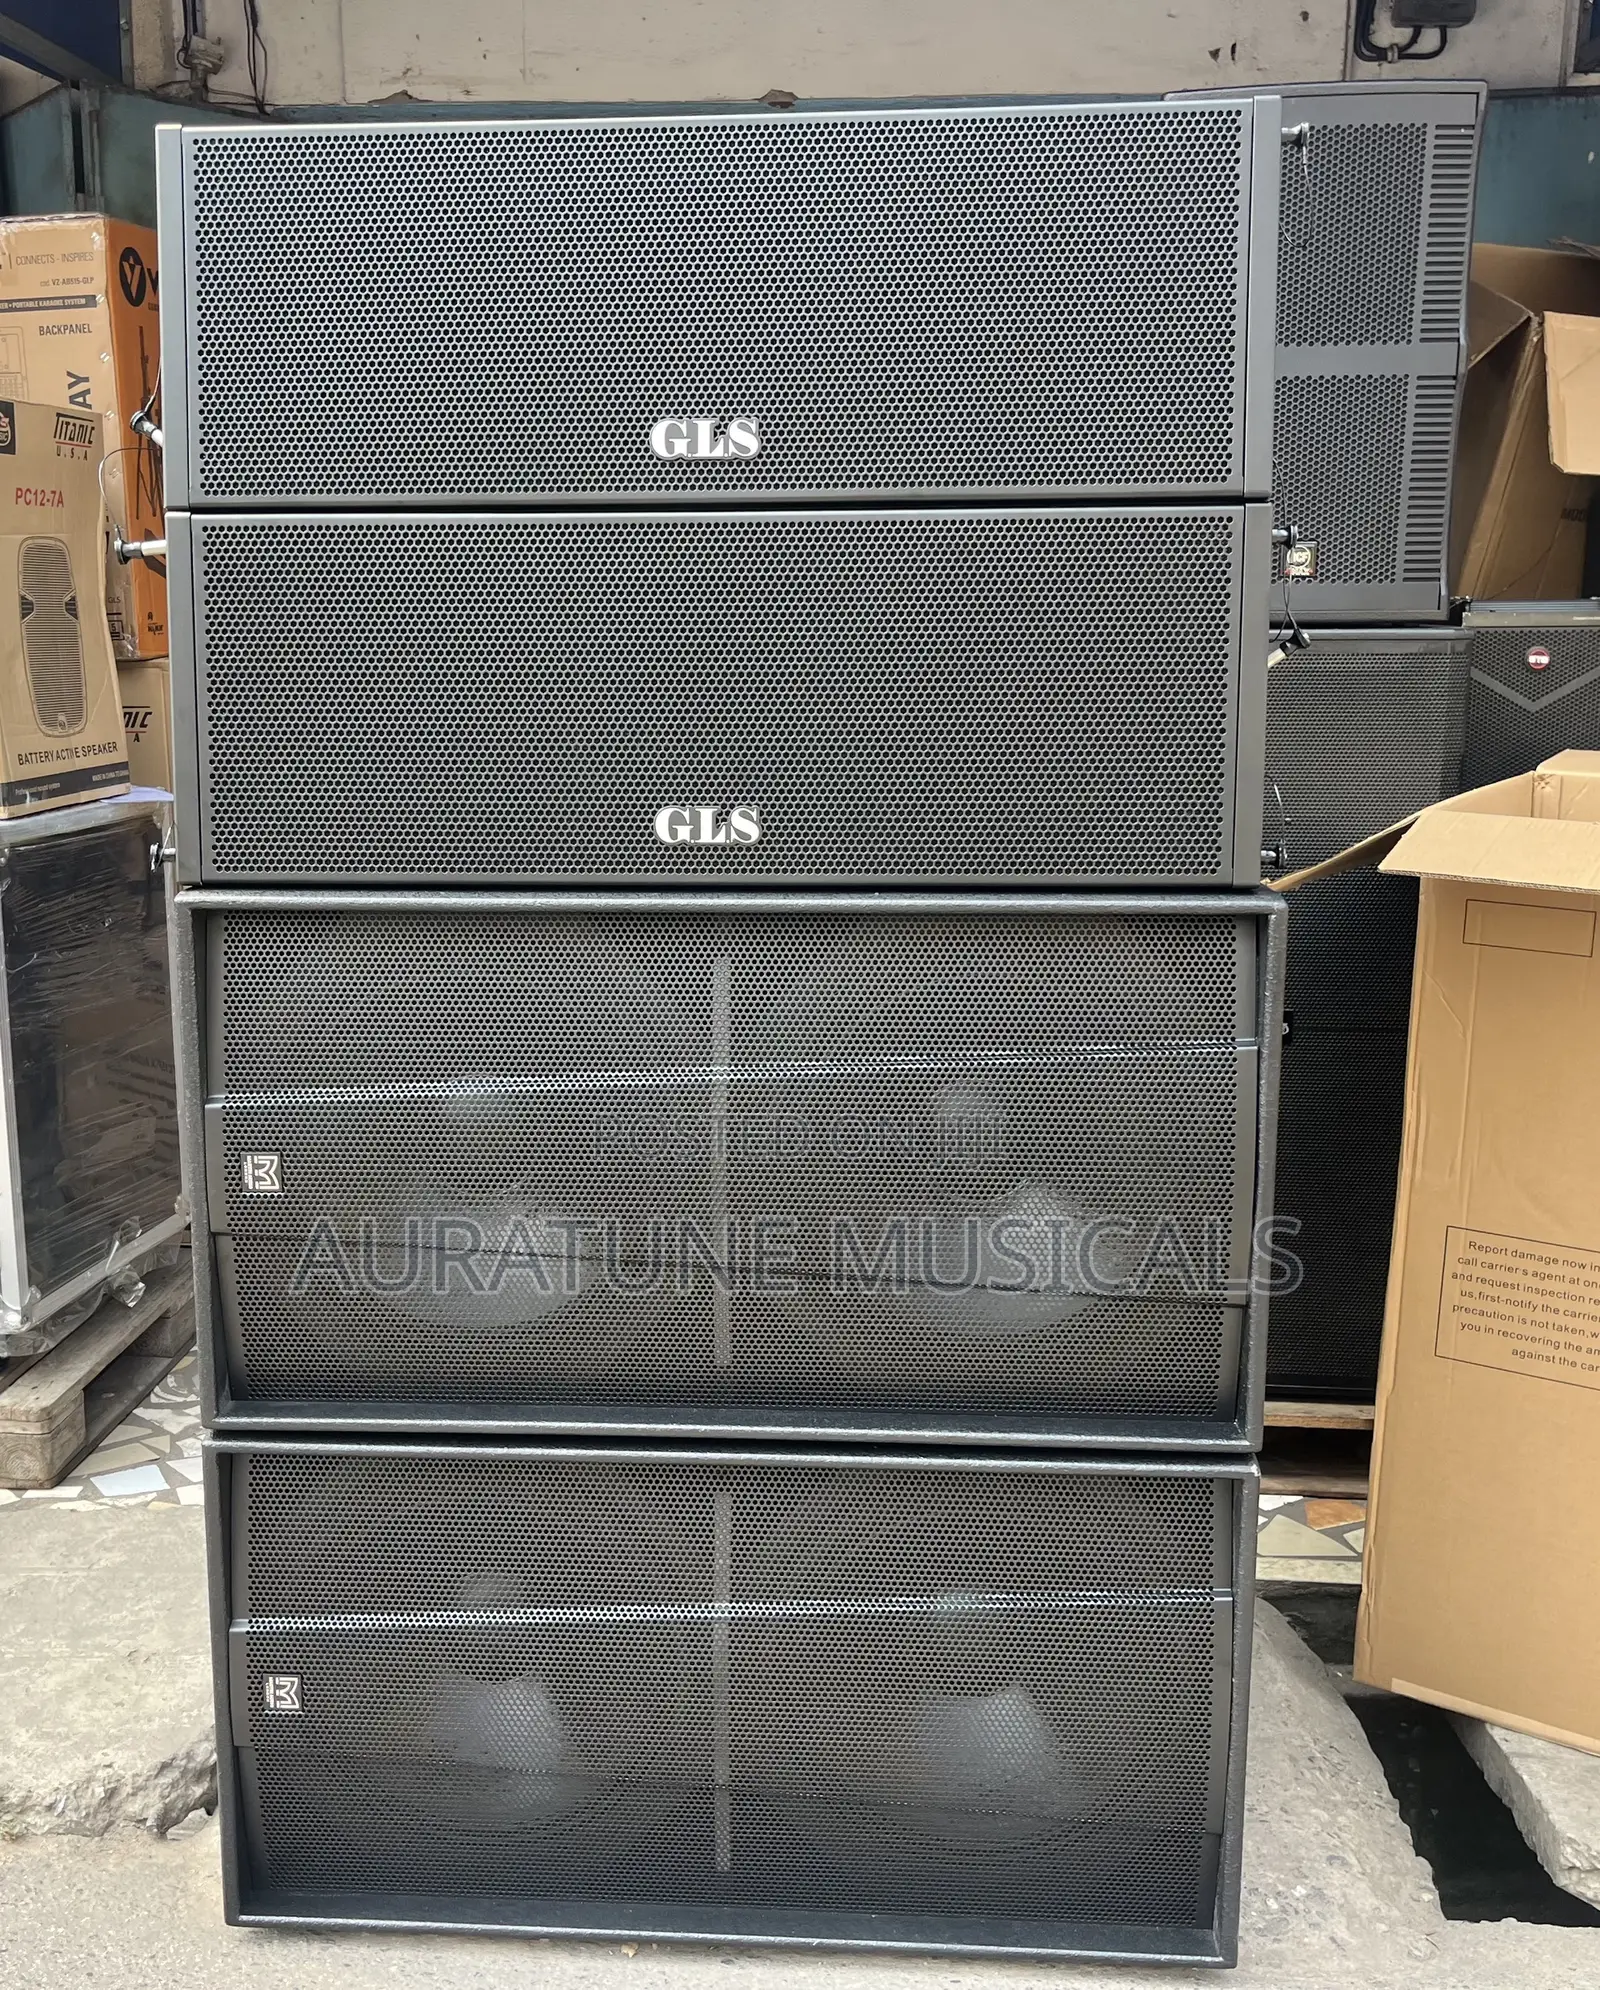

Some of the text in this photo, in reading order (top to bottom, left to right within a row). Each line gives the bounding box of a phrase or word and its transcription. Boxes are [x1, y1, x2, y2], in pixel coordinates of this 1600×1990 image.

[16, 254, 55, 266] CONNECTS
[61, 252, 94, 262] INSPIRES
[12, 301, 39, 309] PORTABLE
[64, 298, 86, 306] SYSTEM
[39, 323, 93, 336] BACKPANEL
[15, 487, 65, 508] PC12-7A
[17, 750, 55, 766] BATTERY
[81, 741, 118, 757] SPEAKER
[1469, 1241, 1508, 1256] Report
[1511, 1249, 1559, 1265] damage
[1563, 1259, 1587, 1269] now
[1457, 1257, 1478, 1267] call
[1532, 1270, 1566, 1282] agent
[1569, 1276, 1580, 1285] at
[1452, 1272, 1473, 1282] and
[1476, 1276, 1520, 1291] request
[1523, 1284, 1585, 1303] inspection
[1452, 1304, 1514, 1323] precaution
[1518, 1316, 1527, 1325] is
[1530, 1319, 1549, 1329] not
[1542, 1304, 1560, 1315] the
[1460, 1322, 1481, 1332] you
[1484, 1324, 1494, 1334] in
[1497, 1330, 1560, 1350] recovering
[1564, 1341, 1582, 1352] the
[1512, 1349, 1556, 1364] against
[1559, 1357, 1577, 1368] the
